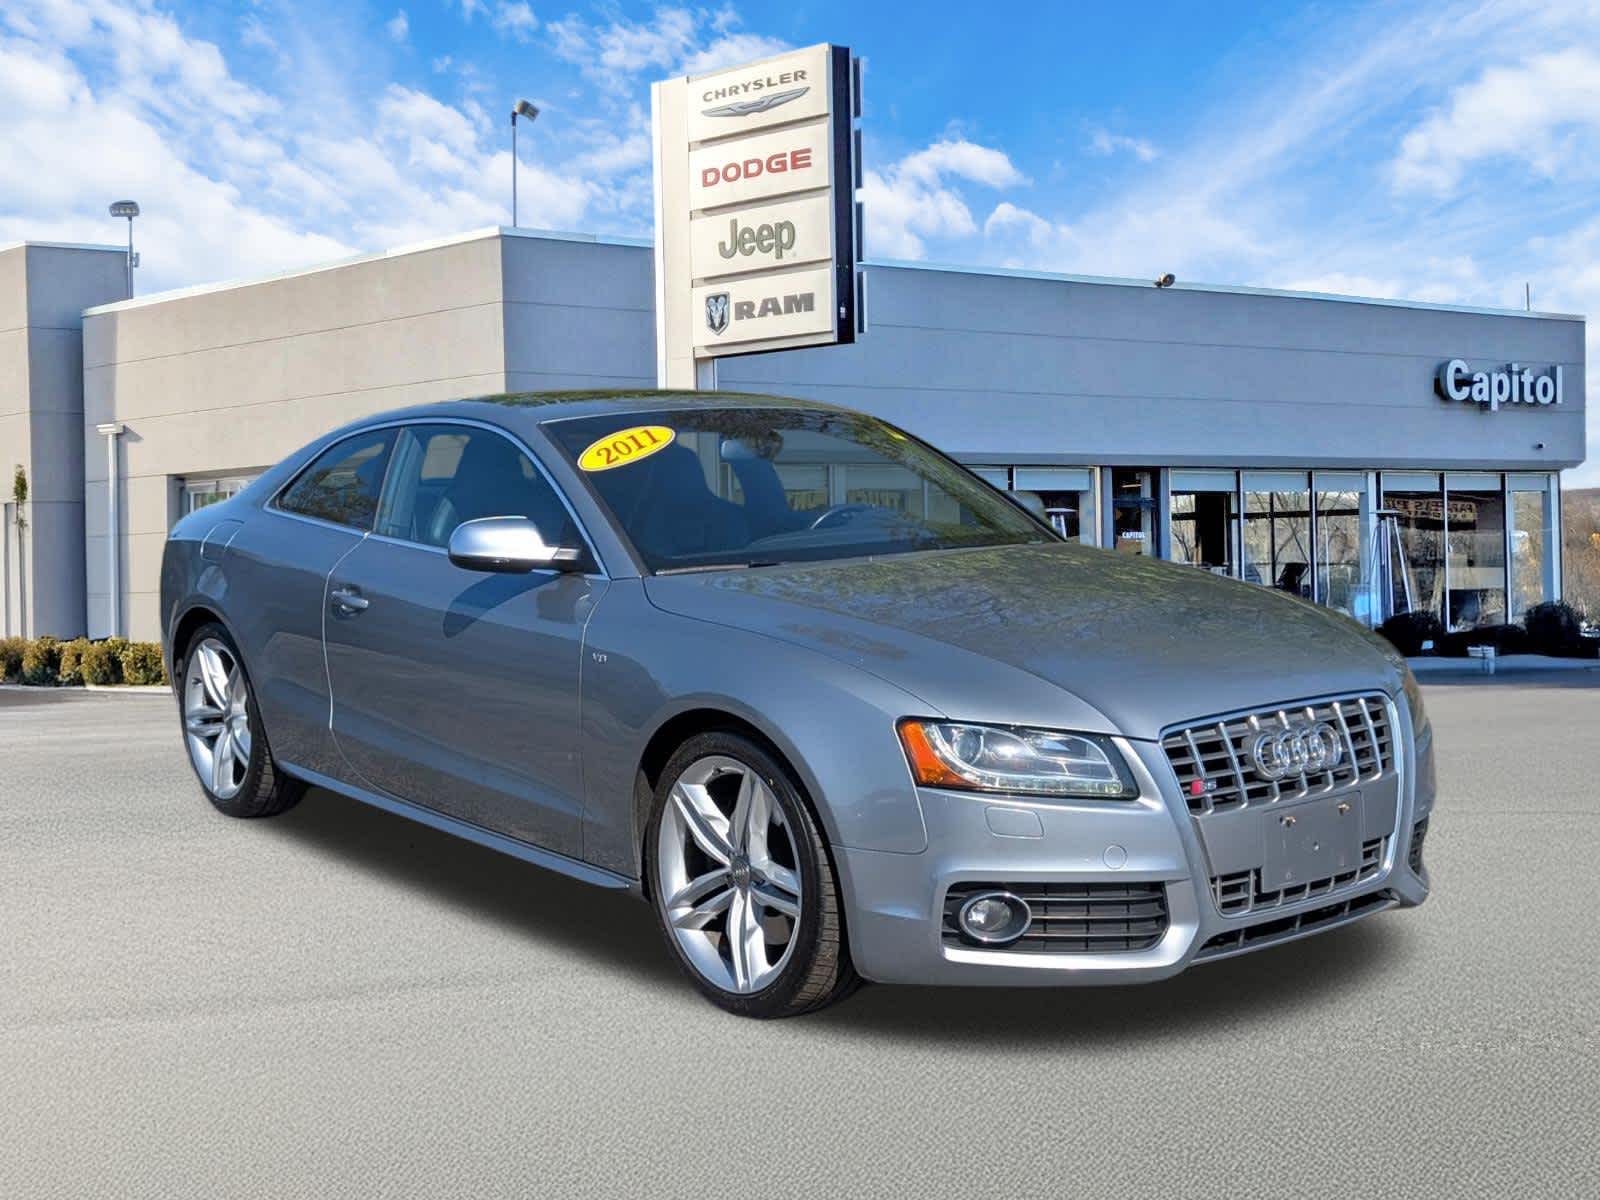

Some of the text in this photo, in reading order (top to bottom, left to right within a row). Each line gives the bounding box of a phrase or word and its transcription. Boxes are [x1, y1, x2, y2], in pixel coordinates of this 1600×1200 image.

[702, 69, 808, 102] CHRYSLER
[702, 147, 812, 188] DODGE
[718, 218, 796, 260] Jeep
[734, 291, 816, 321] RAM
[1446, 359, 1563, 412] Capitol
[596, 429, 662, 465] 2011
